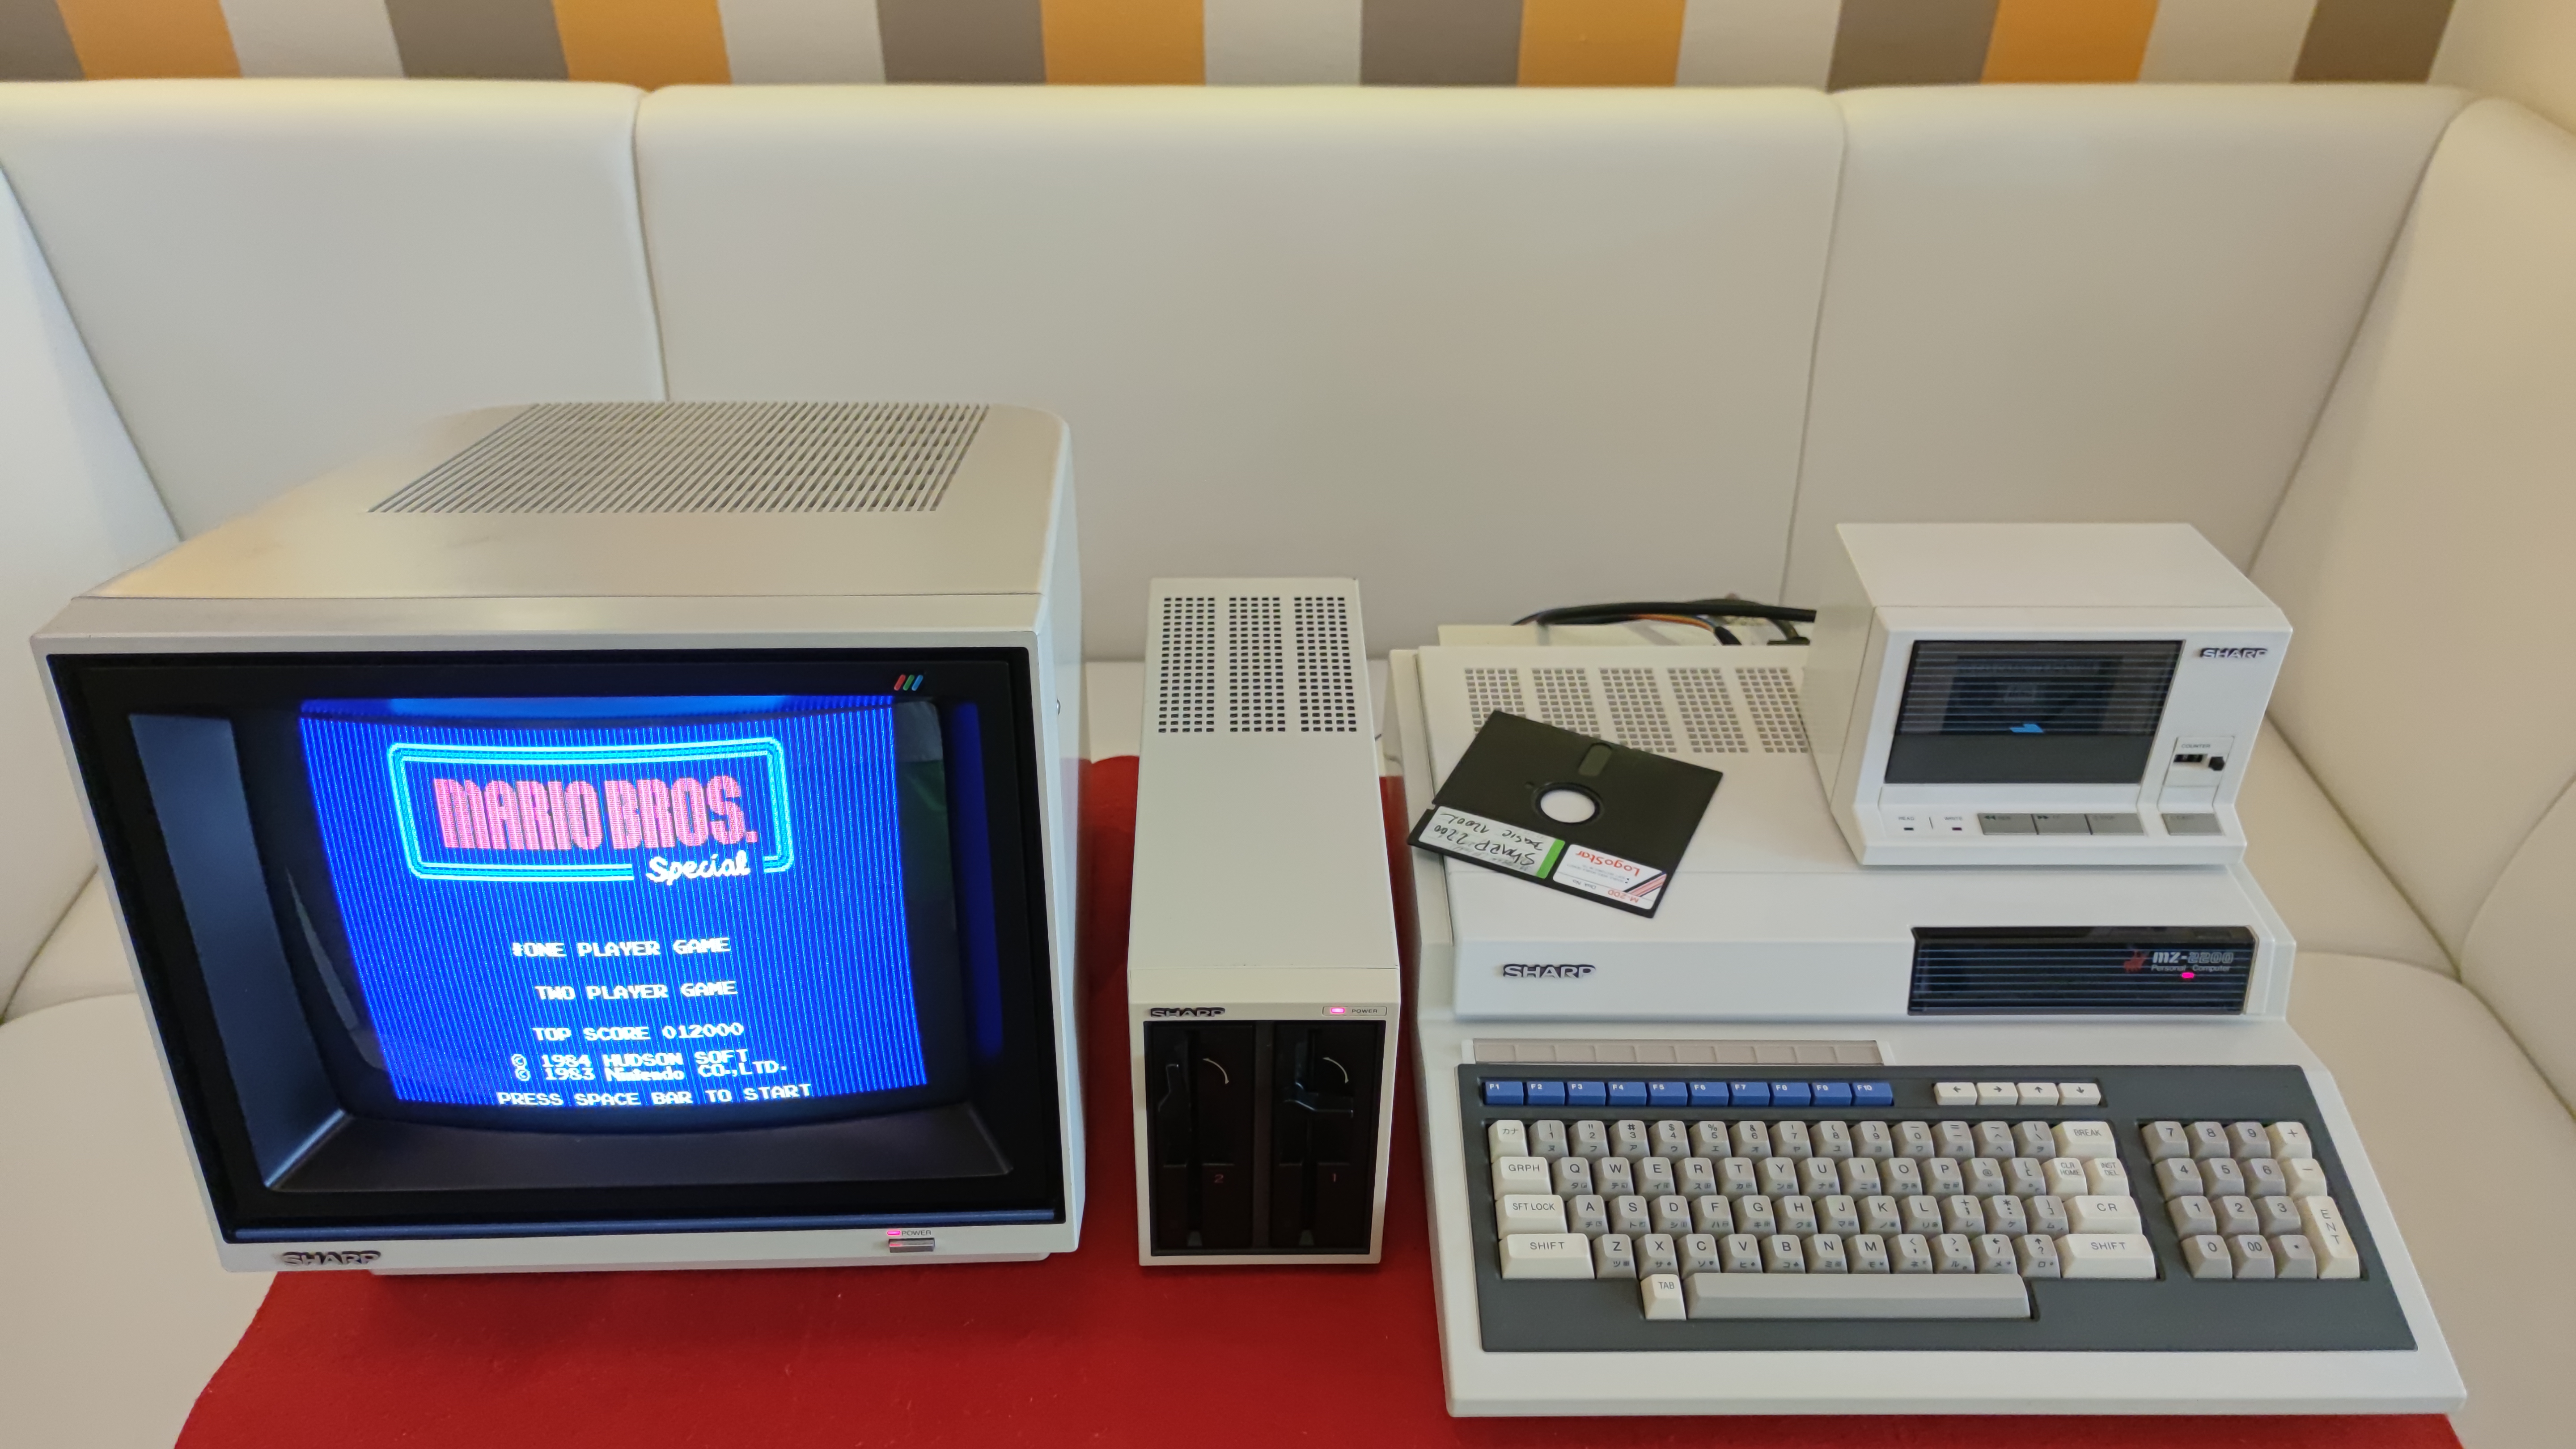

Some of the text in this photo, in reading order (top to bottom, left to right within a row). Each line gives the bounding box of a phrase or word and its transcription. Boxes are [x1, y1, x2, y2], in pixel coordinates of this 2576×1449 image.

[2200, 648, 2267, 658] SHARP
[433, 775, 758, 850] MARIO BROS.
[646, 850, 751, 885] Special
[1576, 851, 1640, 877] LogoStar
[577, 941, 661, 957] PLAYER
[673, 937, 731, 954] GAME
[1503, 964, 1596, 978] SHARP
[535, 981, 738, 1000] TWO PLAYER GAME
[1150, 1008, 1225, 1017] SHARP
[533, 1022, 744, 1042] TOP SCORE 012000
[542, 1054, 592, 1068] 1984
[602, 1052, 683, 1067] HUDSON
[695, 1049, 749, 1065] SOFT
[545, 1068, 596, 1080] 1983
[605, 1068, 685, 1082] Nintendo
[496, 1084, 812, 1106] PRESS SPACE BAR TO START
[2165, 1128, 2174, 1137] 7
[2206, 1128, 2216, 1138] 8
[2247, 1128, 2257, 1138] 9
[1570, 1164, 1580, 1173] Q
[1609, 1164, 1622, 1174] W
[1652, 1164, 1662, 1174] E
[1694, 1164, 1703, 1174] R
[1734, 1164, 1743, 1174] T
[1775, 1164, 1784, 1173] Y
[1817, 1164, 1827, 1174] U
[1861, 1165, 1865, 1174] I
[1898, 1164, 1909, 1174] O
[1940, 1165, 1949, 1174] P
[2180, 1165, 2188, 1174] 4
[2221, 1165, 2230, 1174] 5
[2262, 1165, 2272, 1175] 6
[1214, 1174, 1224, 1183] 2
[1513, 1203, 1555, 1211] SFT LOCK
[1586, 1202, 1595, 1212] A
[1628, 1202, 1638, 1212] S
[1669, 1202, 1678, 1212] D
[1711, 1202, 1719, 1212] F
[1753, 1202, 1763, 1212] G
[1793, 1203, 1804, 1212] H
[1839, 1202, 1845, 1212] J
[1877, 1203, 1888, 1212] K
[1919, 1202, 1929, 1212] L
[2097, 1203, 2118, 1212] CR
[2194, 1203, 2201, 1212] 1
[2235, 1203, 2245, 1212] 2
[2277, 1203, 2287, 1212] 3
[1530, 1241, 1564, 1250] SHIFT
[1612, 1241, 1622, 1251] Z
[1655, 1241, 1664, 1251] X
[1696, 1241, 1707, 1251] C
[1738, 1241, 1747, 1251] V
[1781, 1241, 1792, 1251] B
[1824, 1241, 1834, 1251] N
[1864, 1241, 1877, 1251] M
[2090, 1242, 2125, 1250] SHIFT
[2207, 1242, 2218, 1252] 0
[2247, 1241, 2262, 1252] 00
[283, 1250, 381, 1265] SHARP
[1658, 1281, 1675, 1289] TAB
